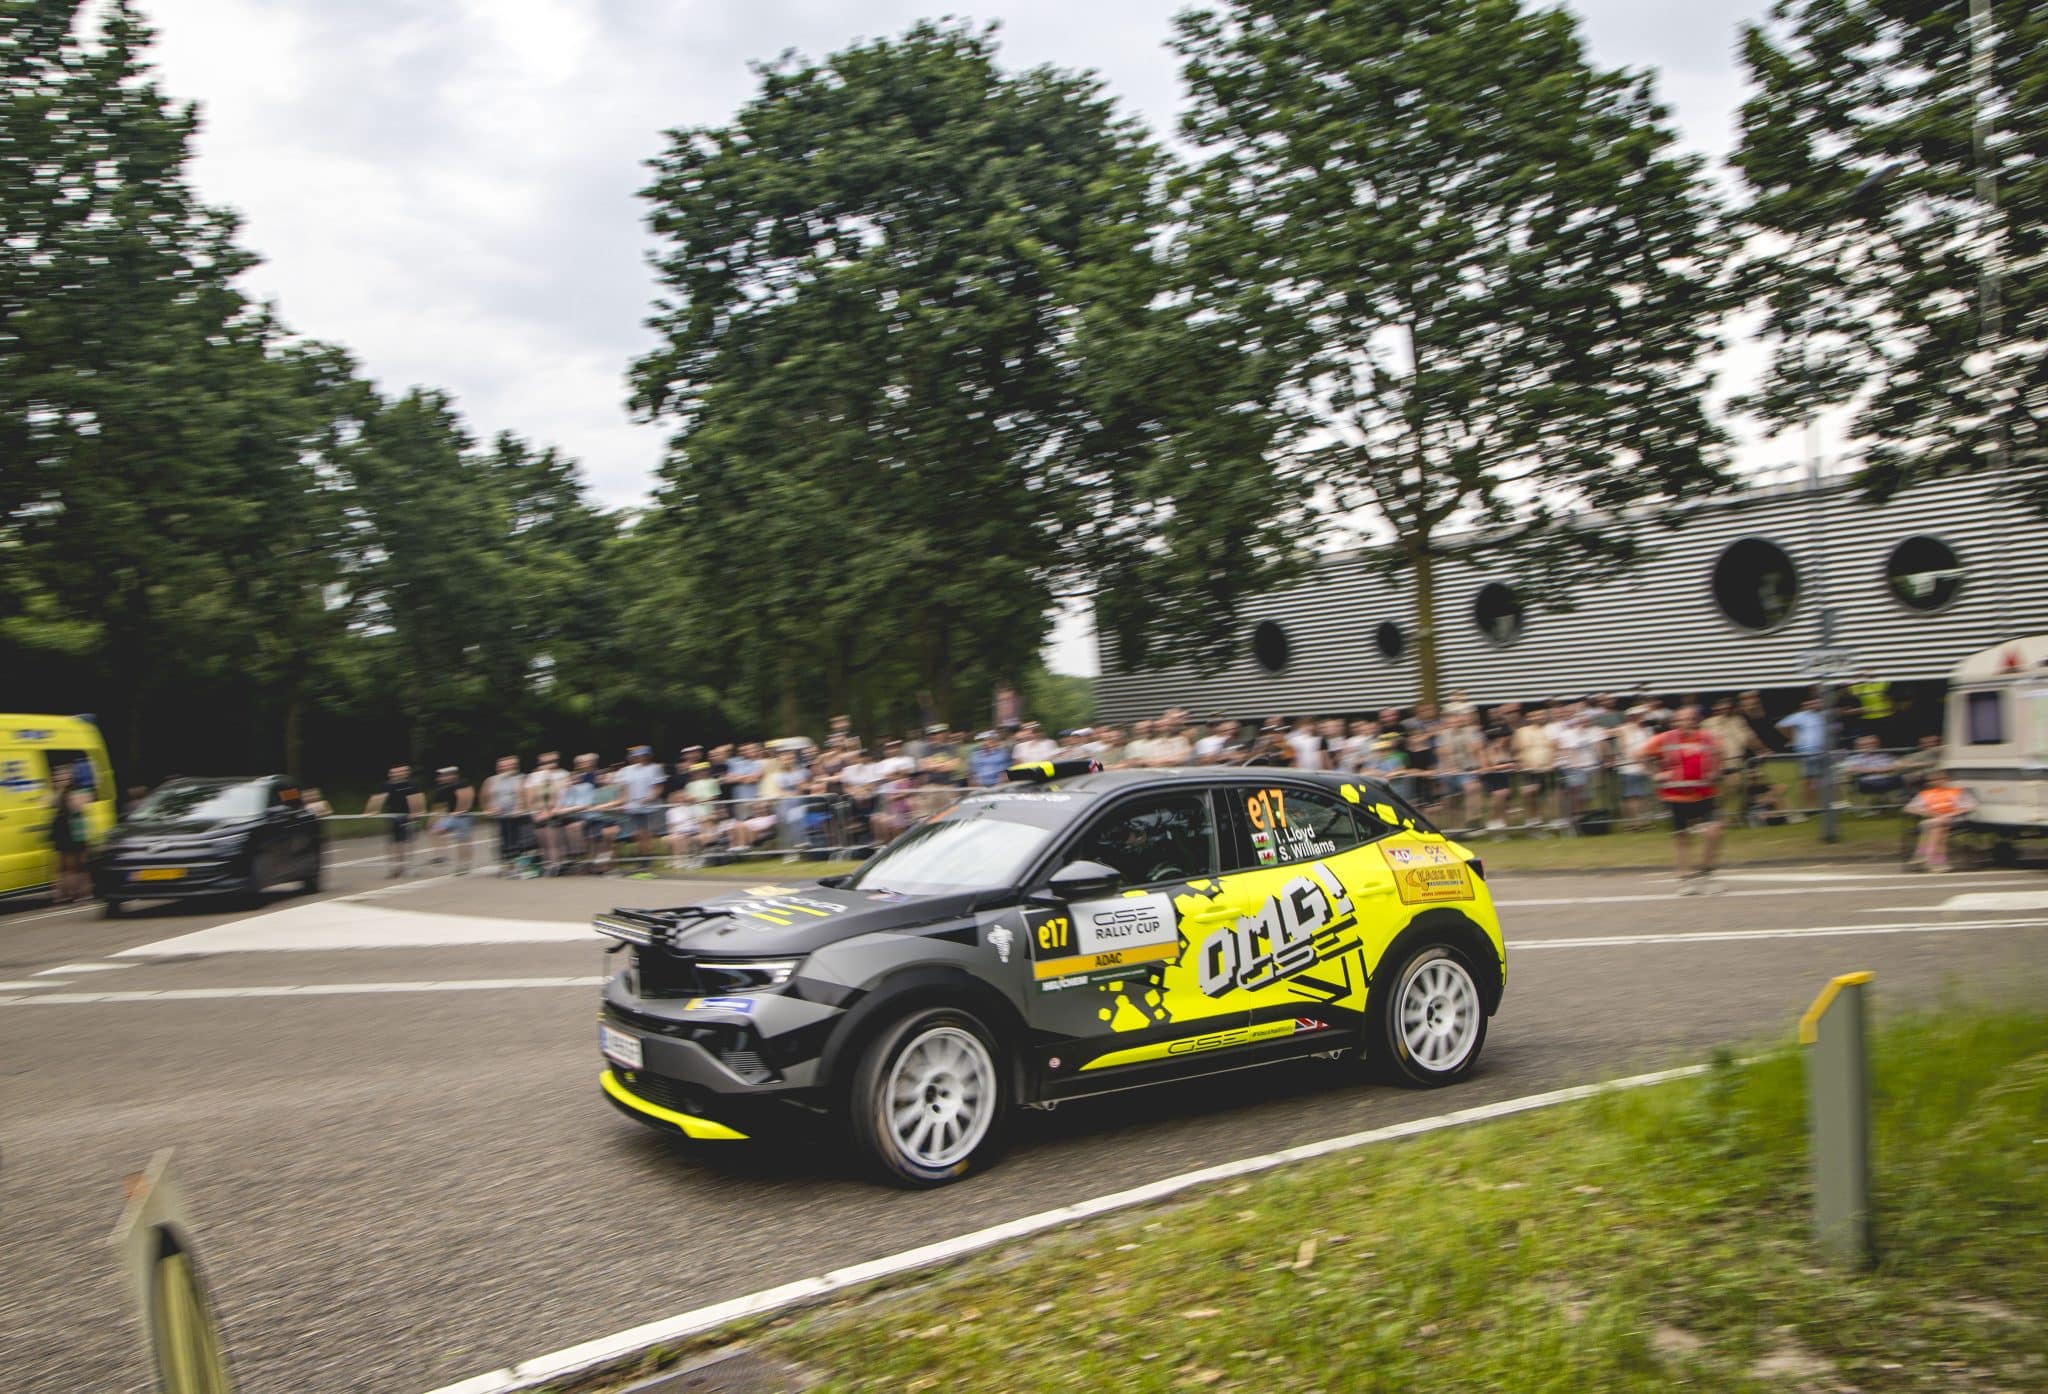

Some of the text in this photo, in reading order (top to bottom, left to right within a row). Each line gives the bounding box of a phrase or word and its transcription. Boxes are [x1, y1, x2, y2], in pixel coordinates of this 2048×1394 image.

[1247, 788, 1287, 830] e17
[1284, 823, 1316, 842] Lloyd
[1279, 840, 1336, 861] S. Williams
[1093, 906, 1158, 926] GSE
[1037, 917, 1069, 949] e17
[1095, 921, 1160, 939] RALLY CUP
[1198, 861, 1355, 998] OMG!
[1095, 952, 1123, 967] ADAC
[1167, 1030, 1249, 1054] GSE
